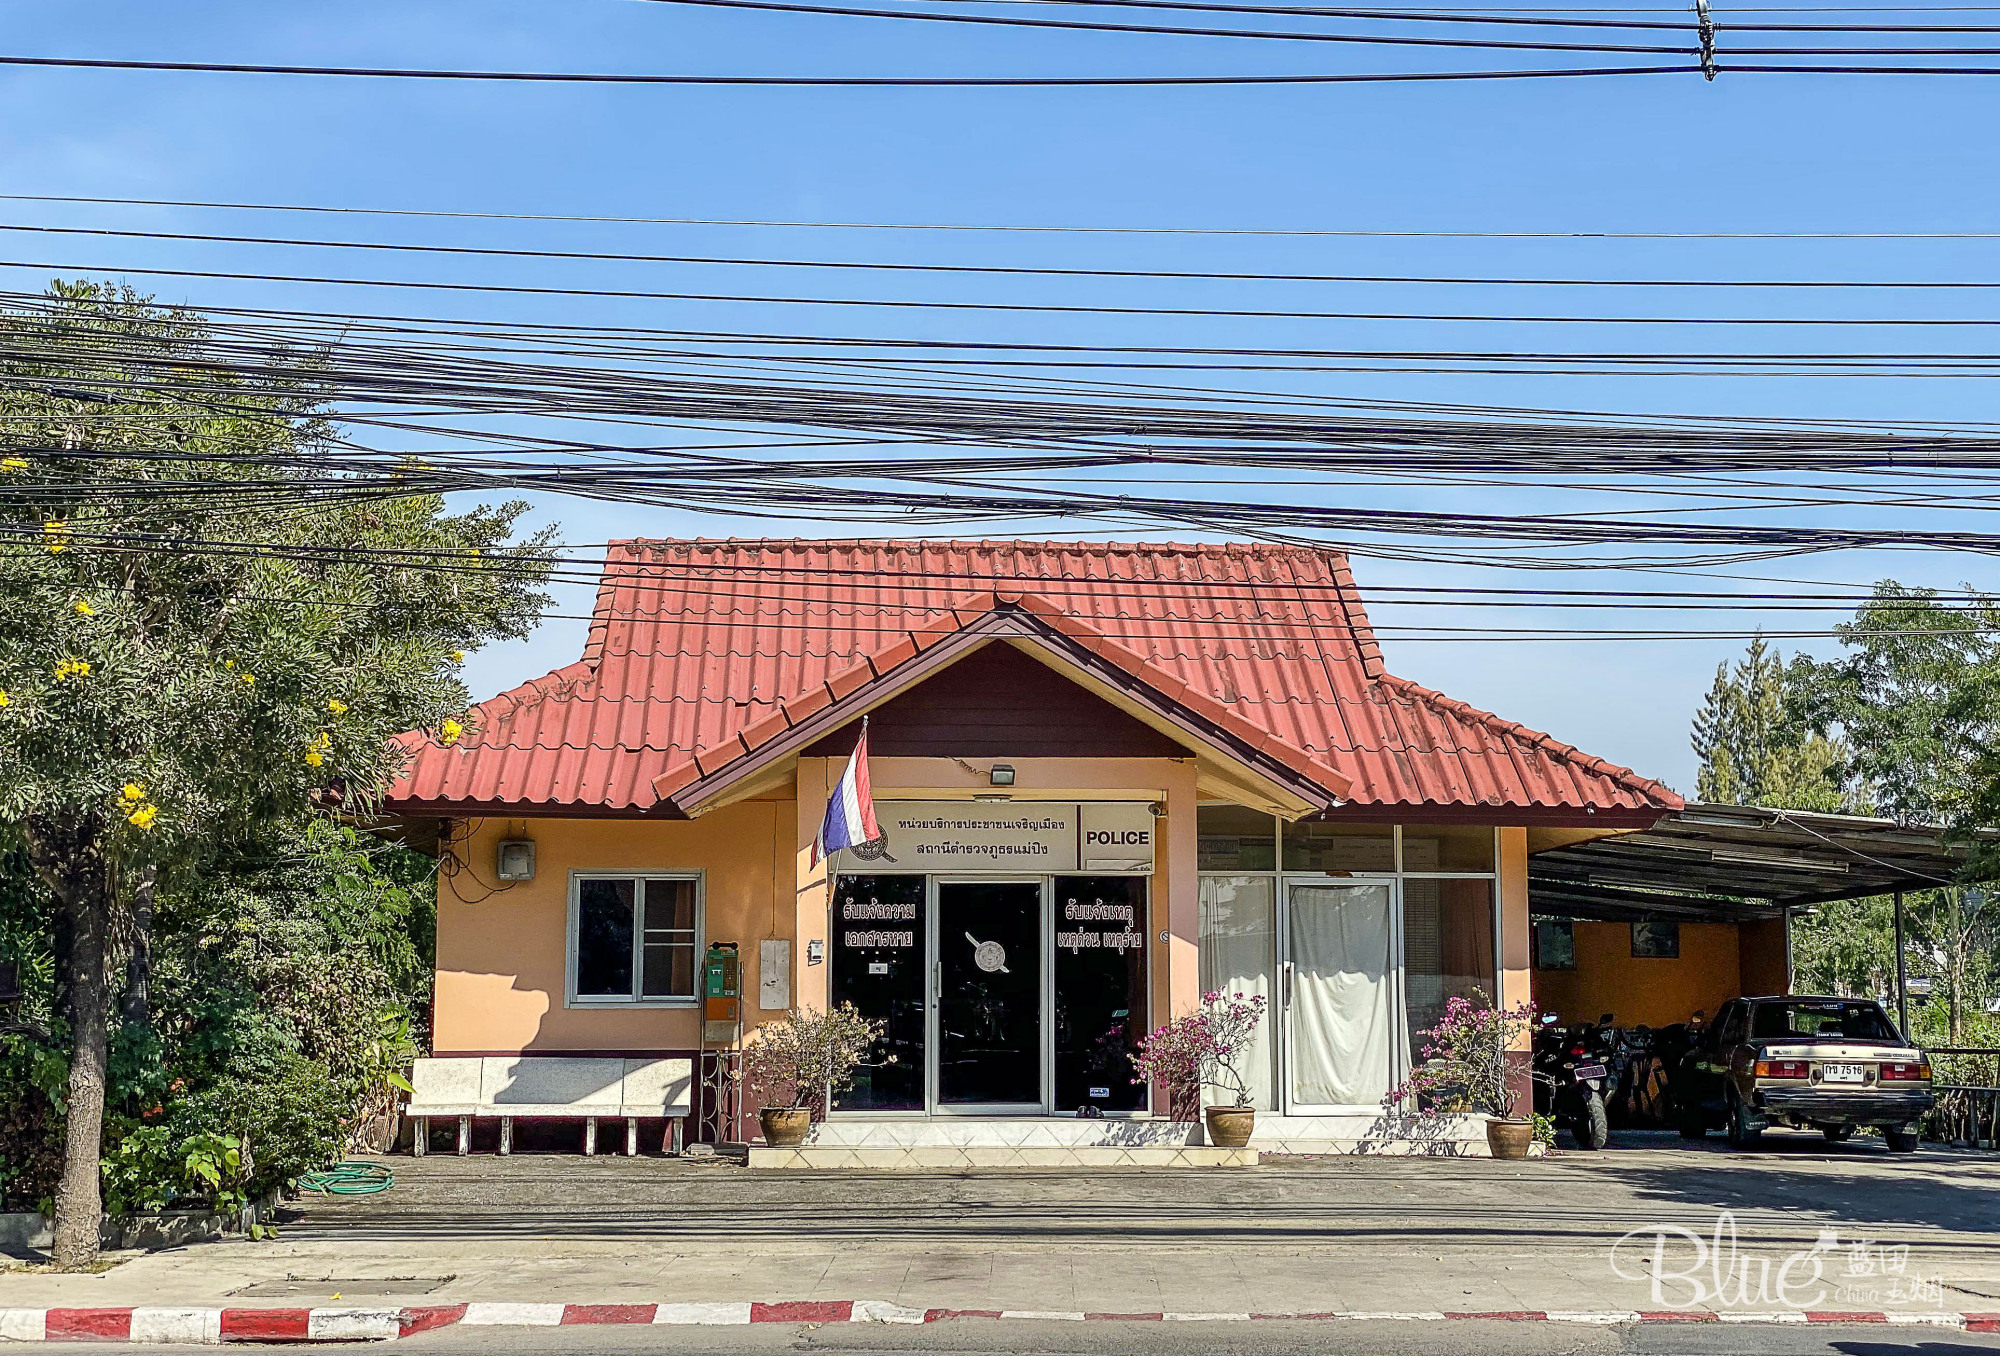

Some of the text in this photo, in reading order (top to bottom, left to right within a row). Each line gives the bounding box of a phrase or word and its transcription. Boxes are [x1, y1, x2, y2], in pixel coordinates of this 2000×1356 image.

[1086, 830, 1149, 845] POLICE
[843, 897, 916, 919] รับแจ้งความ
[1065, 898, 1134, 928] รับแจ้งเหตุ
[845, 930, 913, 947] เอกสารหาย
[1057, 926, 1142, 954] เหตุด่วน เหตุร้าย
[1841, 1065, 1863, 1075] 7516
